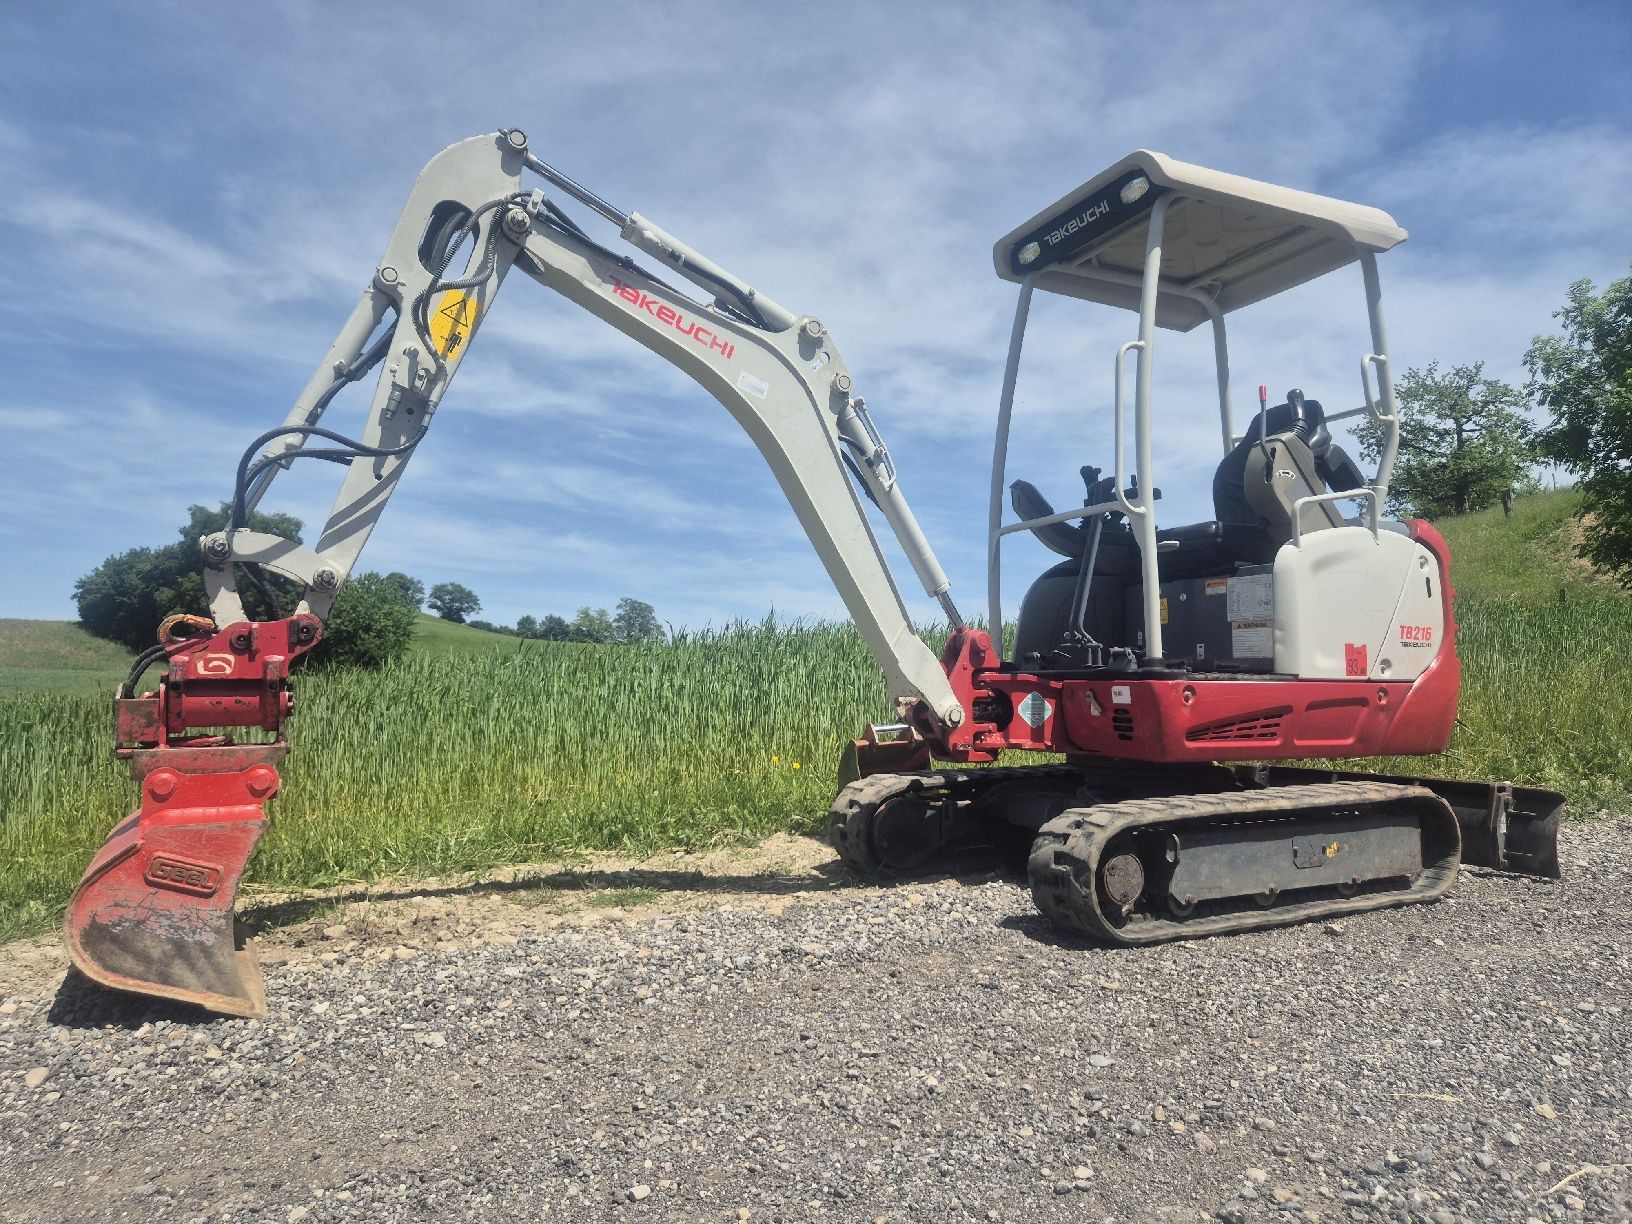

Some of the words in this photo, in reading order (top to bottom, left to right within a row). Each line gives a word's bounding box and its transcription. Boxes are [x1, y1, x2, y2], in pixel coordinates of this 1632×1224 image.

[1044, 200, 1110, 245] TAKEUCHI
[608, 274, 735, 360] TAKEUCHI
[1399, 625, 1432, 641] TB216
